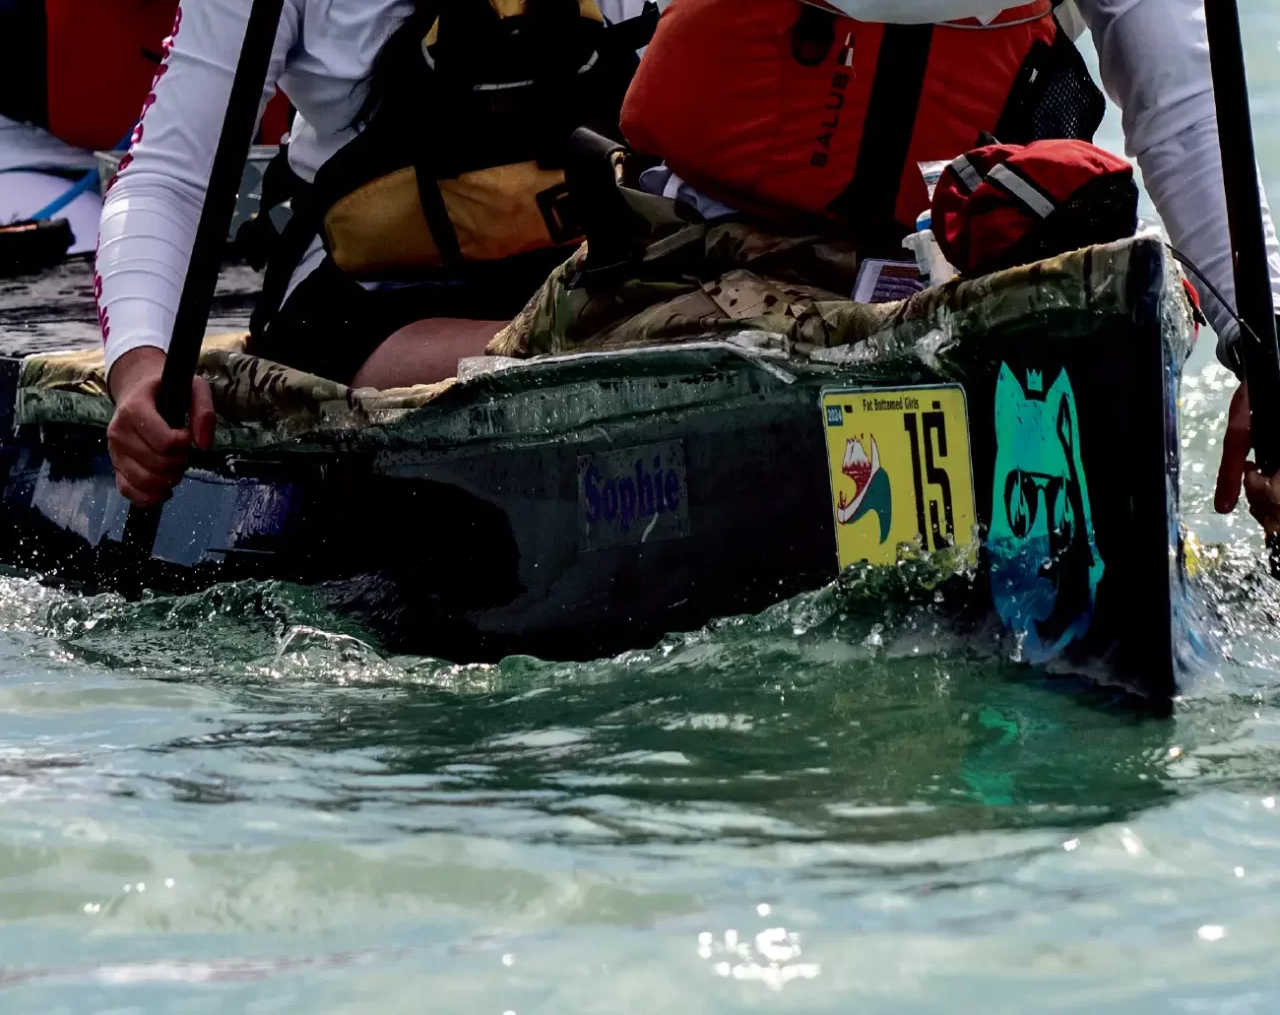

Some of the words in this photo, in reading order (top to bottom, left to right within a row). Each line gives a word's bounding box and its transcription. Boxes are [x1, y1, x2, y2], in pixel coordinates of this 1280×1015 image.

[827, 408, 843, 422] 2024
[862, 398, 873, 411] Fat
[904, 396, 919, 410] Girls
[584, 454, 680, 533] Sophie
[903, 411, 955, 552] 15
